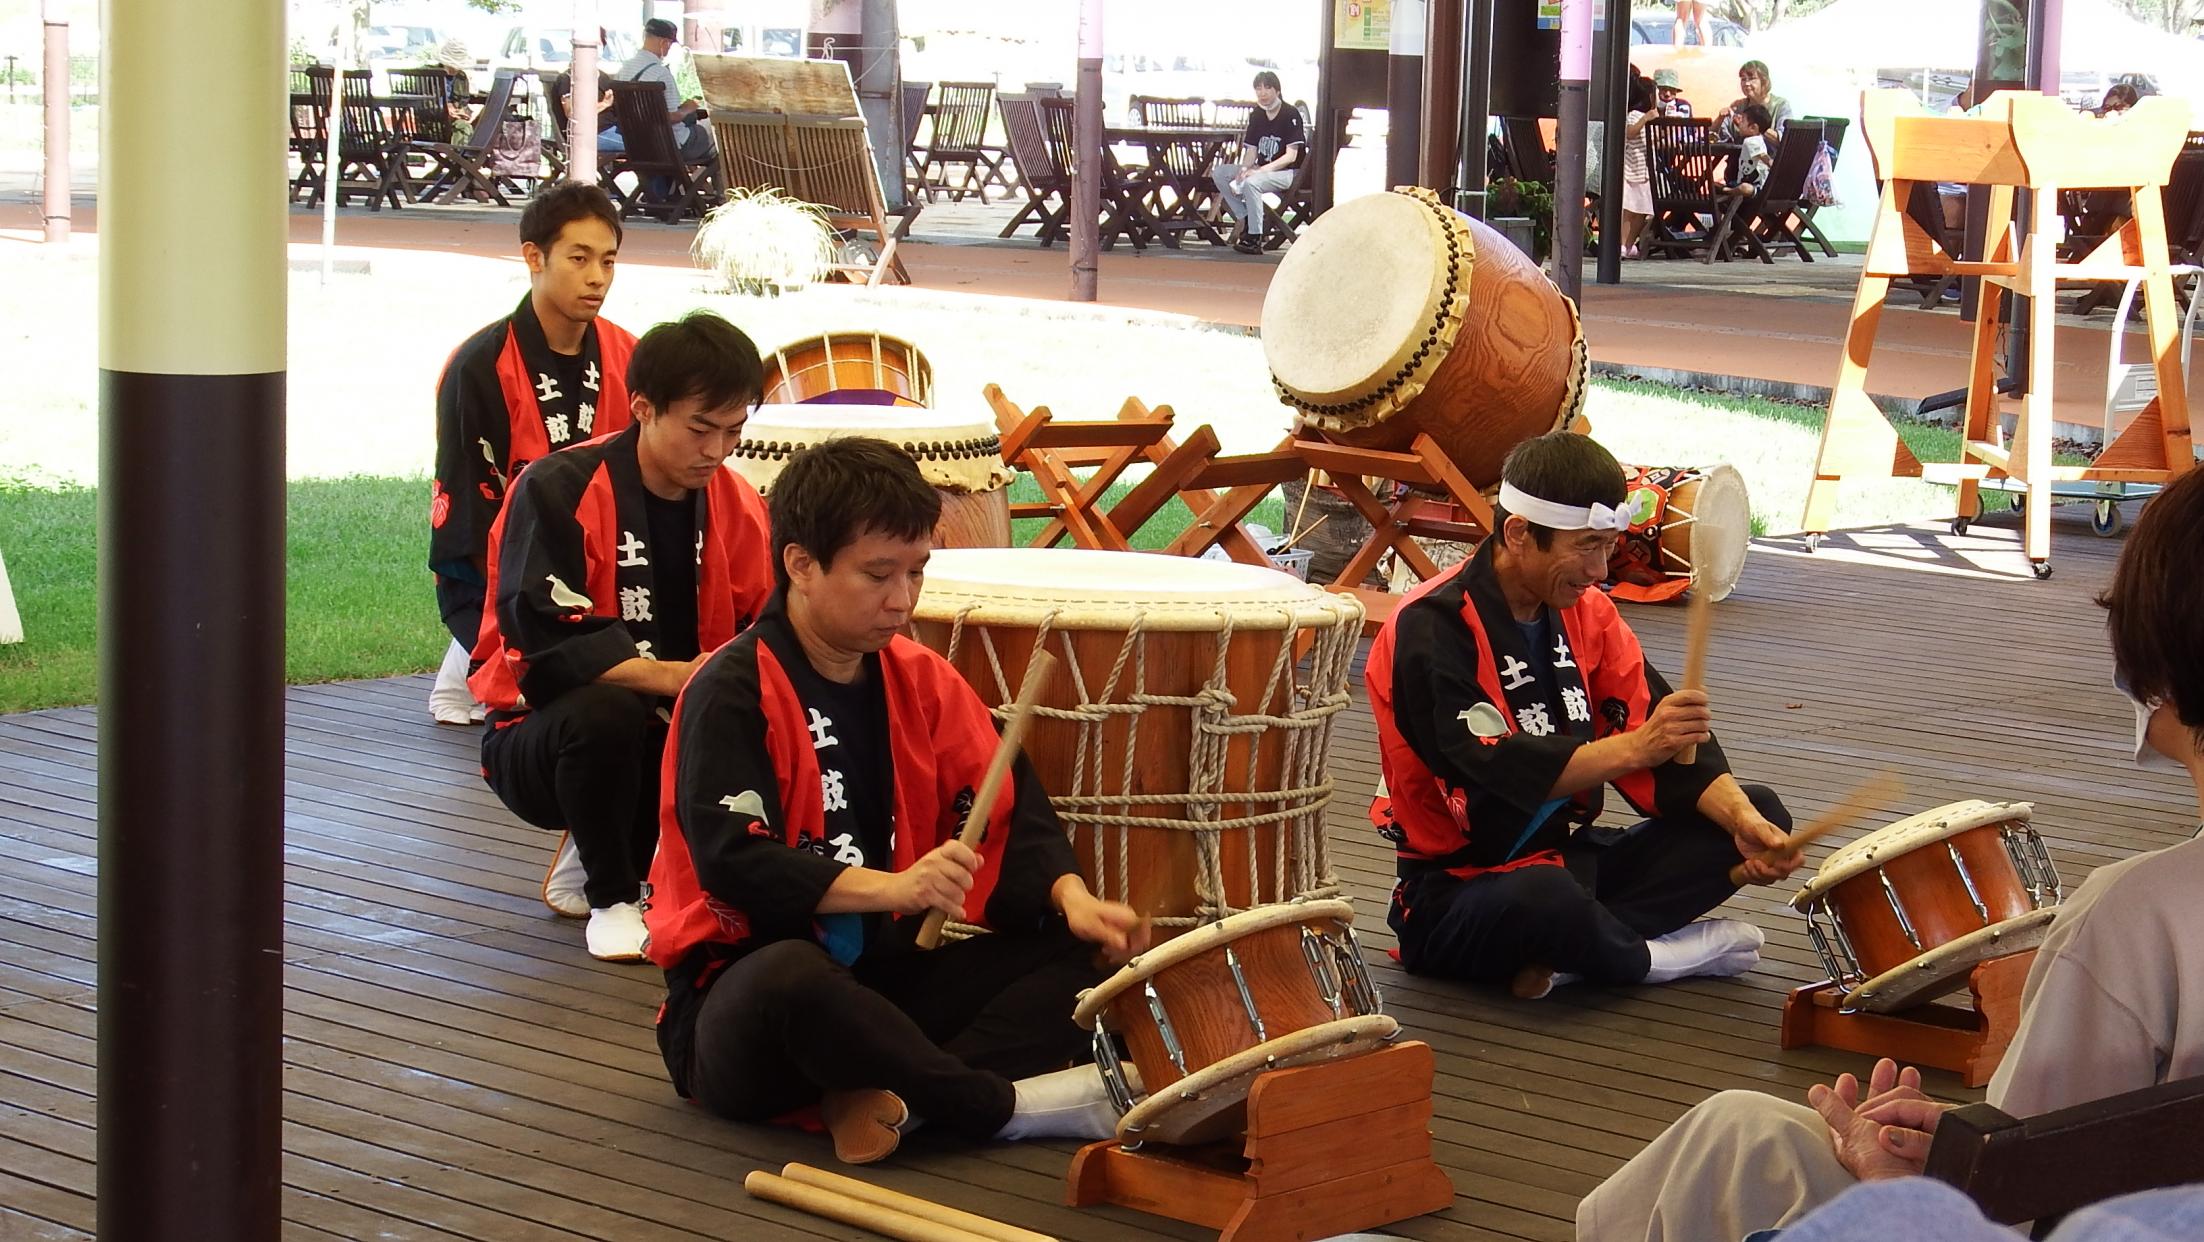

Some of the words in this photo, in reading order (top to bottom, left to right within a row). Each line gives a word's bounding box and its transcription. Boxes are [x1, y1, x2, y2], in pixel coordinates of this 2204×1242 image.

[535, 373, 570, 443] 土鼓
[577, 361, 600, 434] 土鼓
[1500, 655, 1555, 736] 土鼓
[1553, 634, 1591, 722] 土鼓
